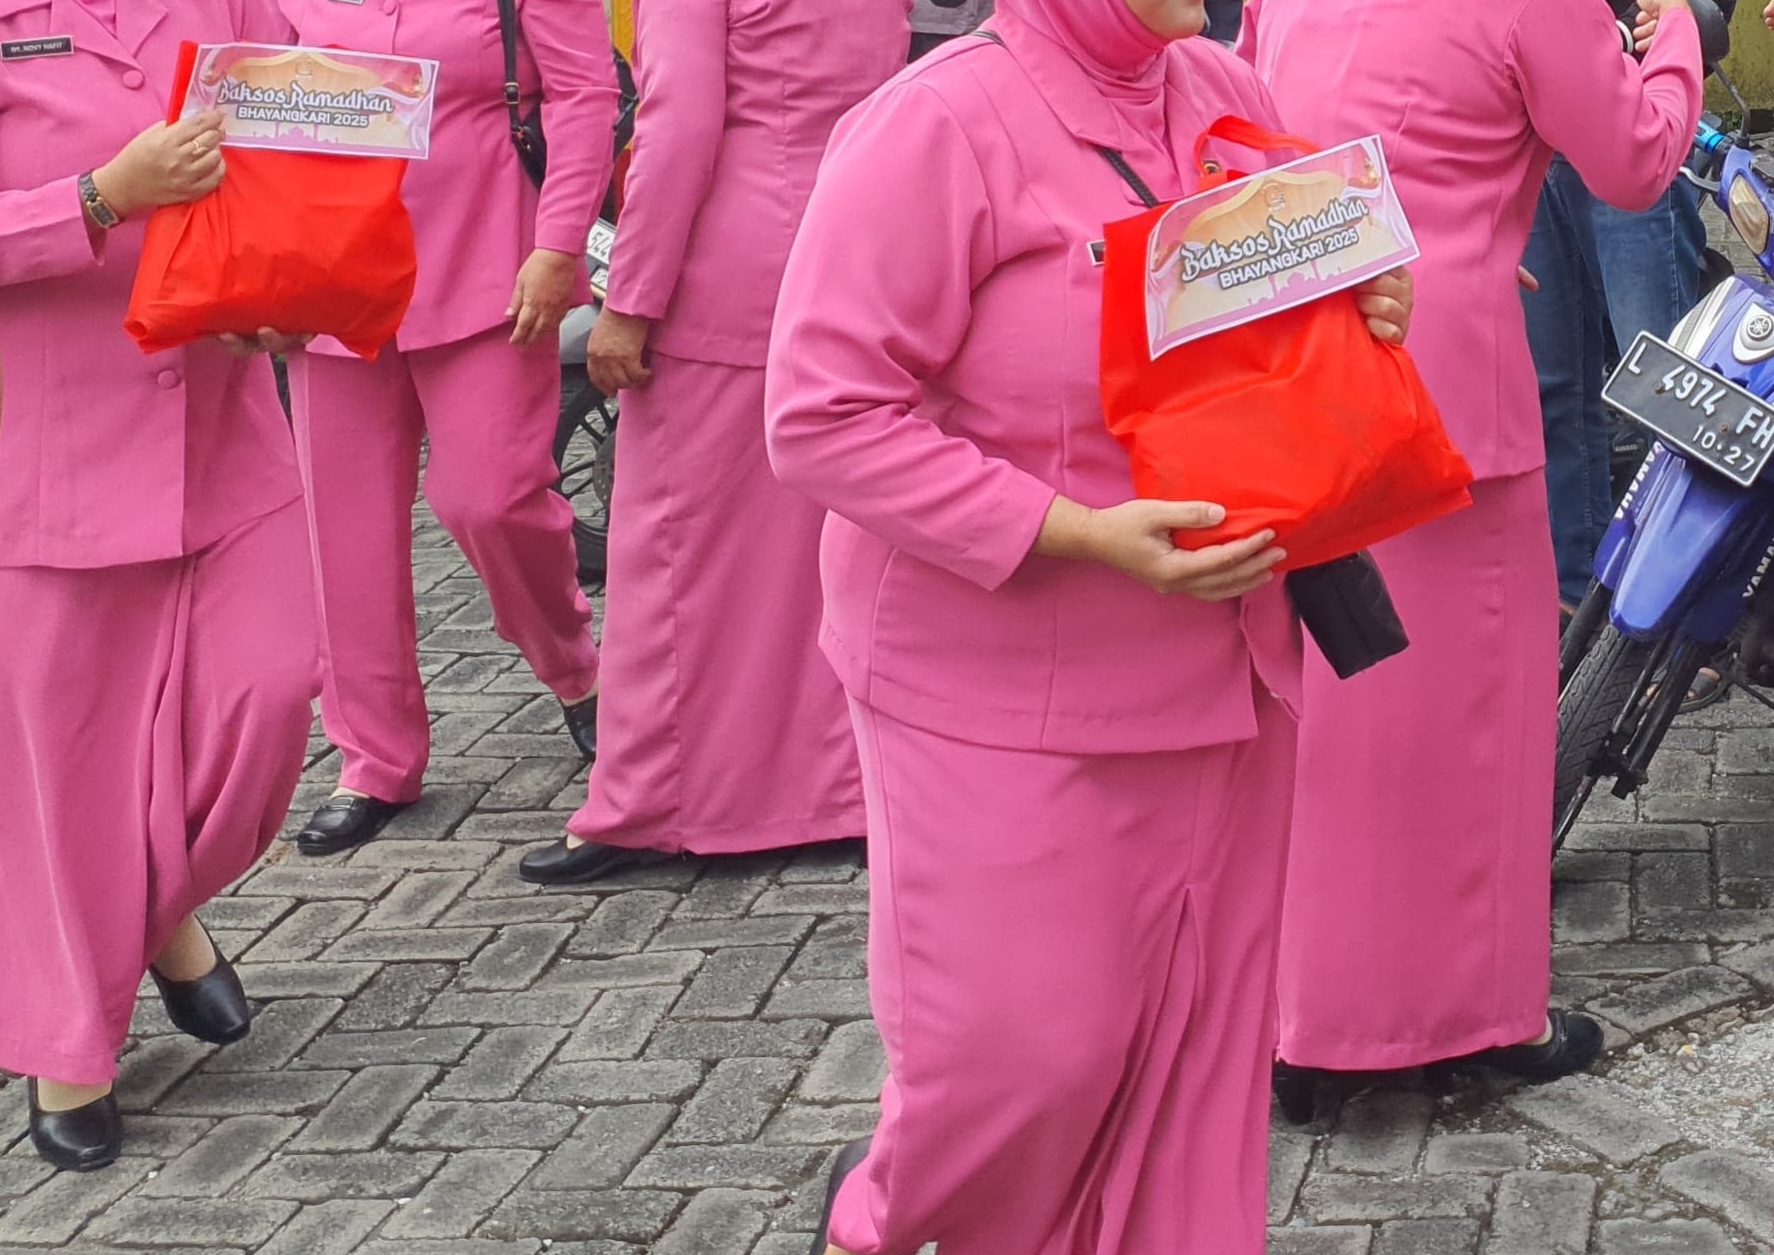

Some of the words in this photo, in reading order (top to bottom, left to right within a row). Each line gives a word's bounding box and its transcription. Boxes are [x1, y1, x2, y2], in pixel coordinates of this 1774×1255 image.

[217, 79, 288, 105] Baksos
[284, 82, 394, 113] Ramadhan
[237, 106, 331, 126] BHAYANGKARI
[332, 111, 370, 128] 2025
[1181, 232, 1270, 283] Baksos
[1268, 198, 1369, 254] Ramadhan
[1219, 239, 1325, 290] BHAYANGKARI
[1324, 226, 1359, 253] 2025
[1628, 343, 1646, 375] L
[1661, 364, 1727, 416] 4974
